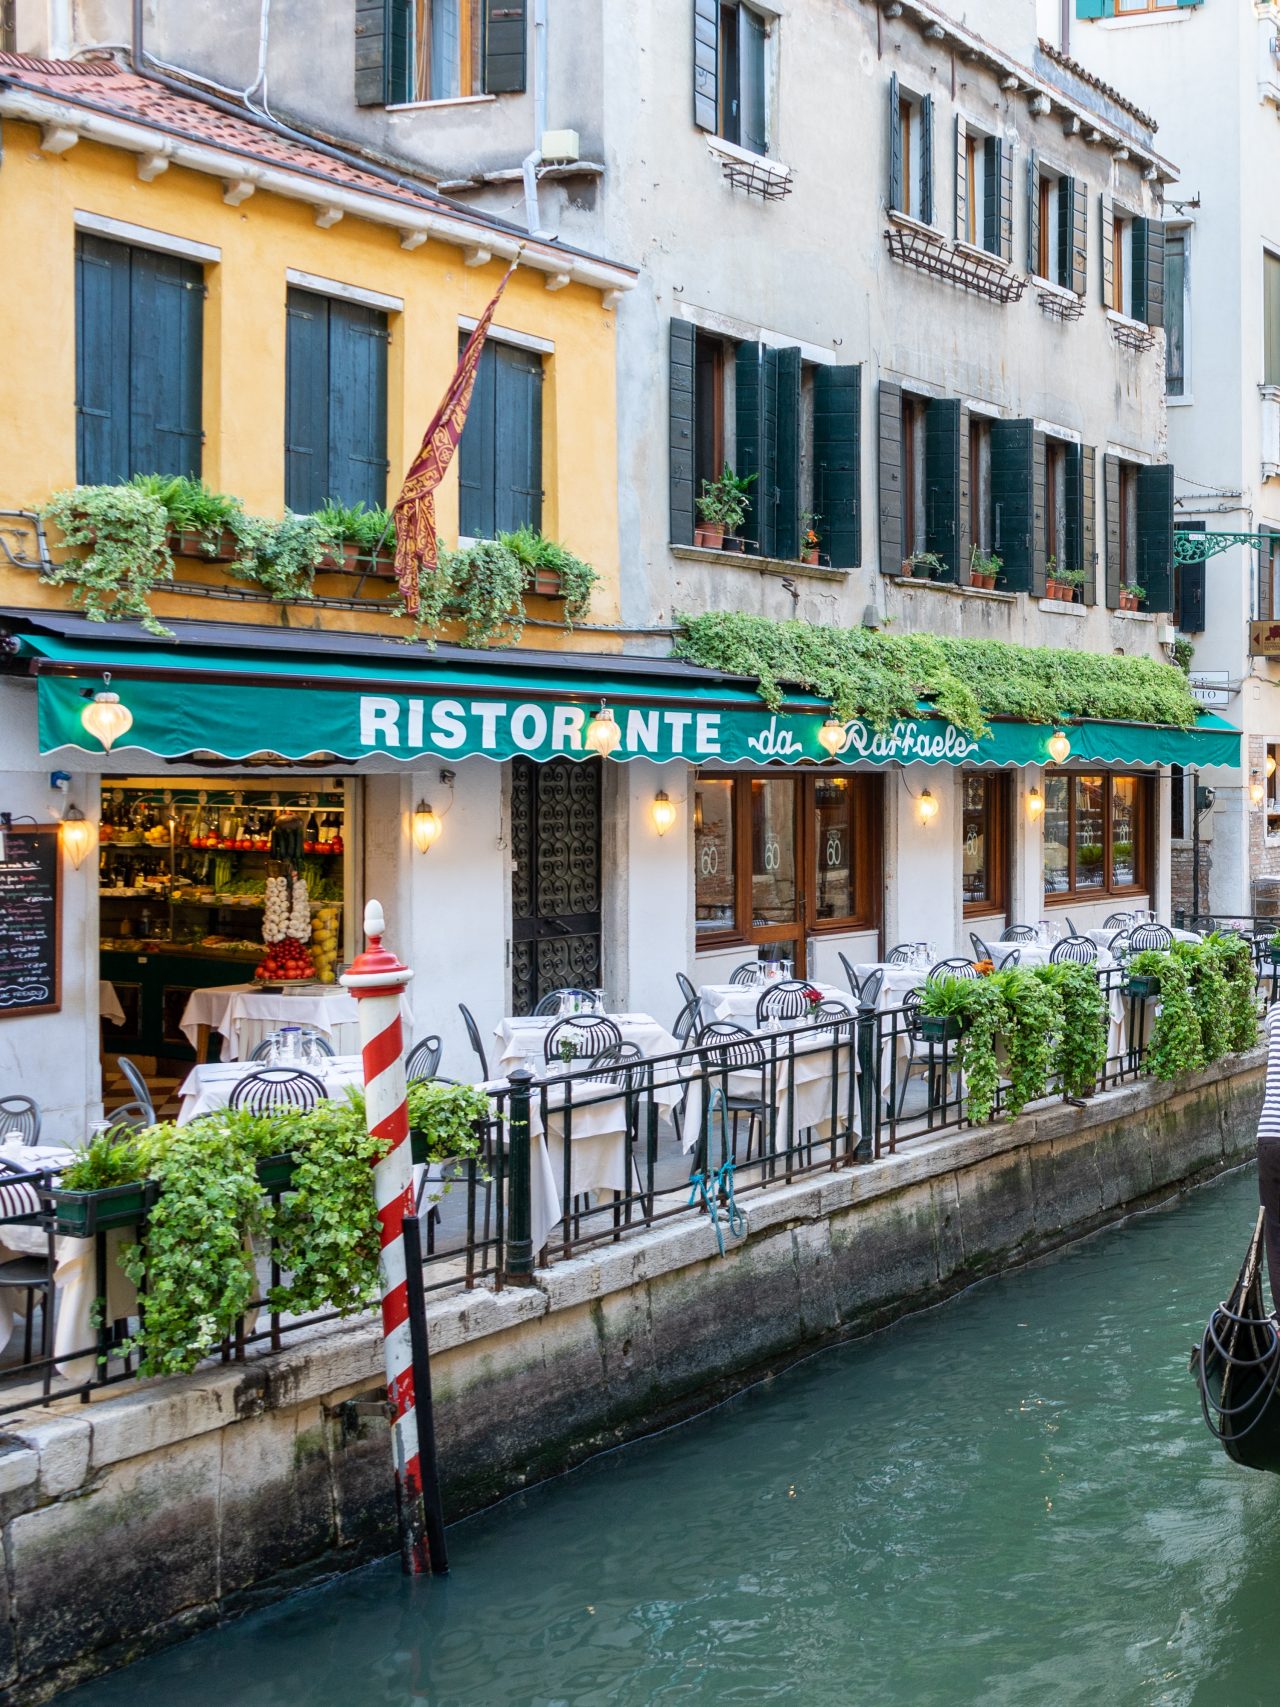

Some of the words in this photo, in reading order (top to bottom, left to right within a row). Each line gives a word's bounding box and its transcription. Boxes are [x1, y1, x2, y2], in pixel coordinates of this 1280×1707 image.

[748, 716, 803, 755] da
[836, 719, 979, 757] Raffaele
[701, 846, 718, 875] 60
[765, 843, 780, 870] 60
[826, 840, 841, 865] 60
